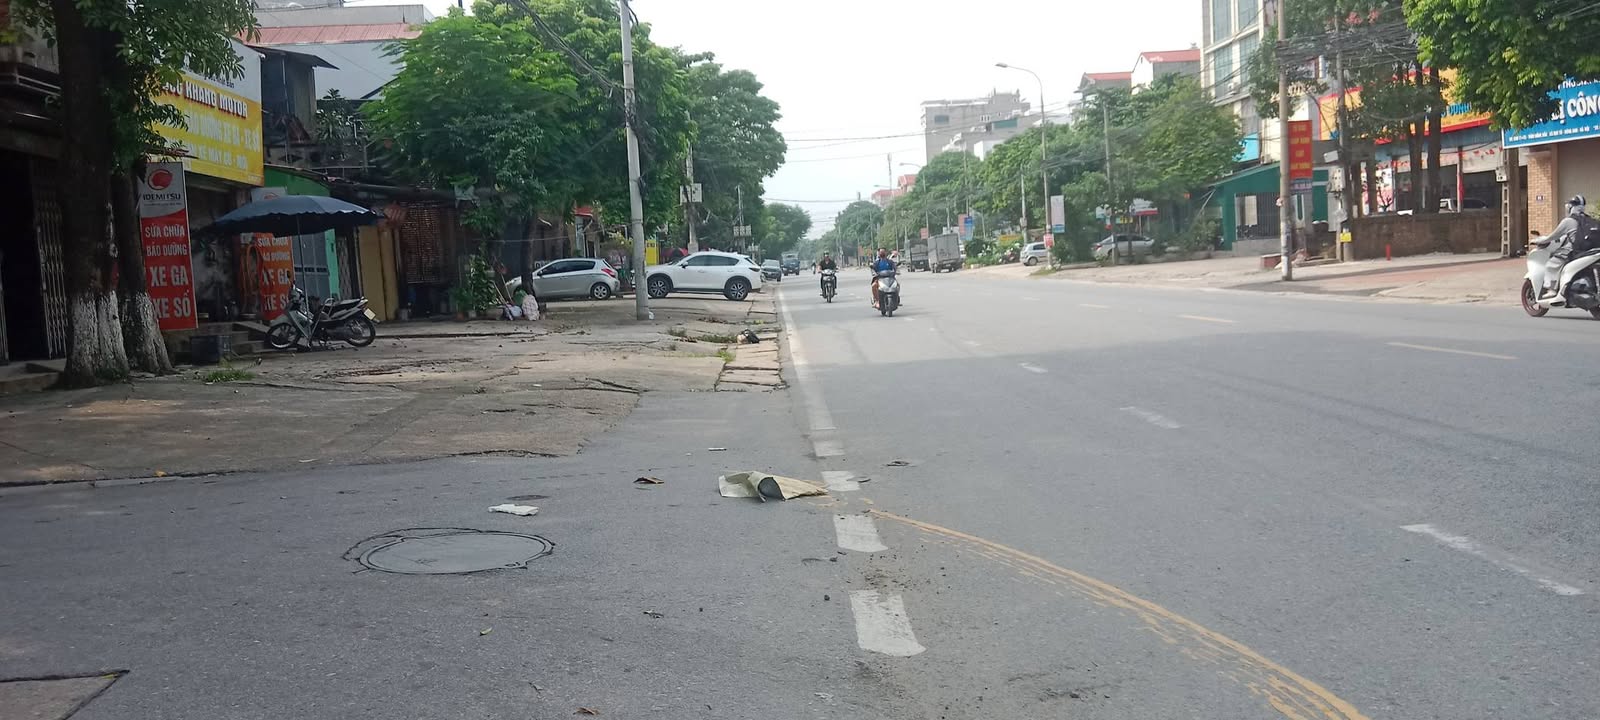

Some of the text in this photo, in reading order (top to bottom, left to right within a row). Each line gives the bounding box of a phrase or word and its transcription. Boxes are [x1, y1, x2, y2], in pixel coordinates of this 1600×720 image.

[185, 80, 217, 107] KHANG
[219, 93, 248, 118] MOTOR
[143, 192, 182, 201] IDEMITSU
[145, 223, 186, 238] SỬA CHỮA
[146, 241, 188, 257] BẢO DƯỠNG
[150, 265, 189, 288] XE GA
[152, 289, 191, 319] XE SỐ
